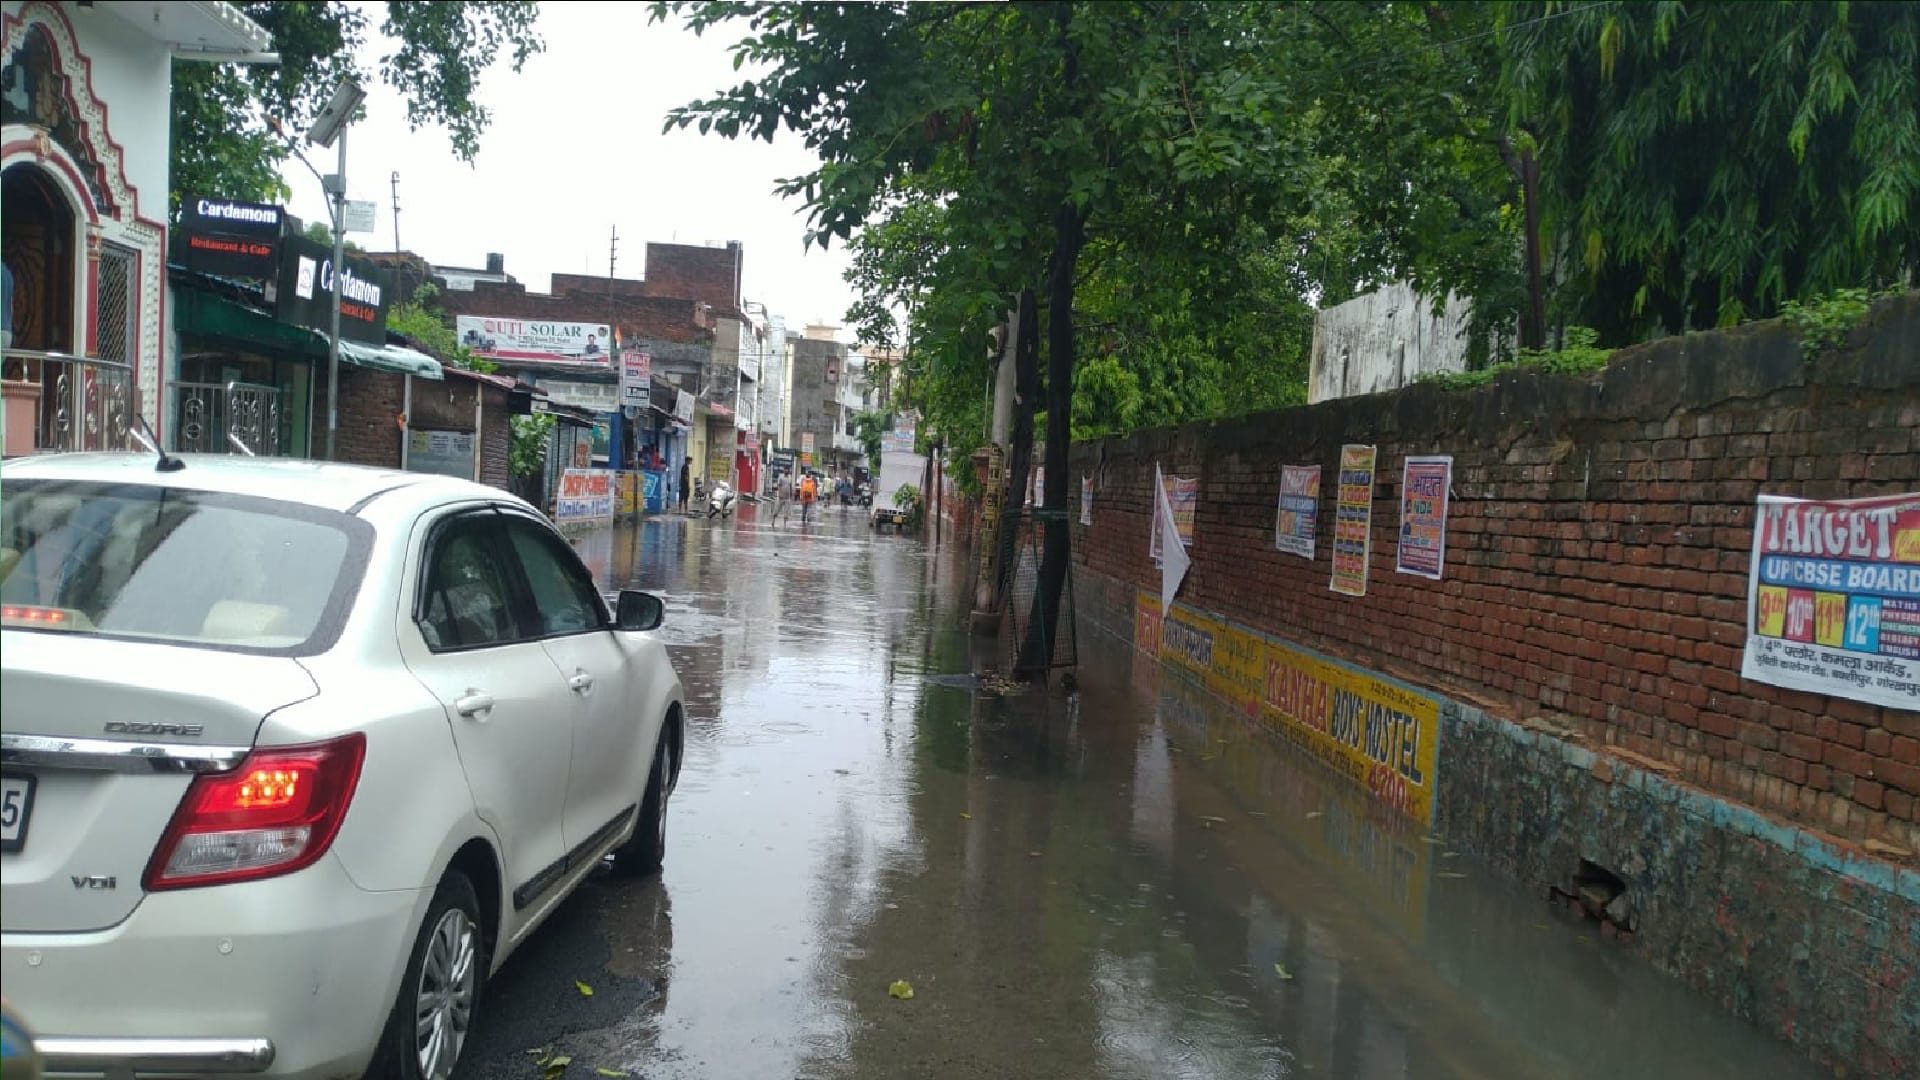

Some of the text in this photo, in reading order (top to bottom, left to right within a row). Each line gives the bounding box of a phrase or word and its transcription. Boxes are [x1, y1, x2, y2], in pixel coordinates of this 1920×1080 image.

[197, 199, 277, 223] Cardamom
[530, 324, 582, 337] SOLAR
[1767, 504, 1897, 559] TARGET
[1882, 599, 1918, 610] MATHS
[1760, 591, 1880, 645] 9th 10th 11th 12th
[1820, 652, 1862, 669] कमला
[104, 721, 204, 736] DZIRE
[1264, 658, 1329, 736] KANHA
[1331, 687, 1364, 750] BOYS
[1364, 700, 1424, 787] HOSTEL
